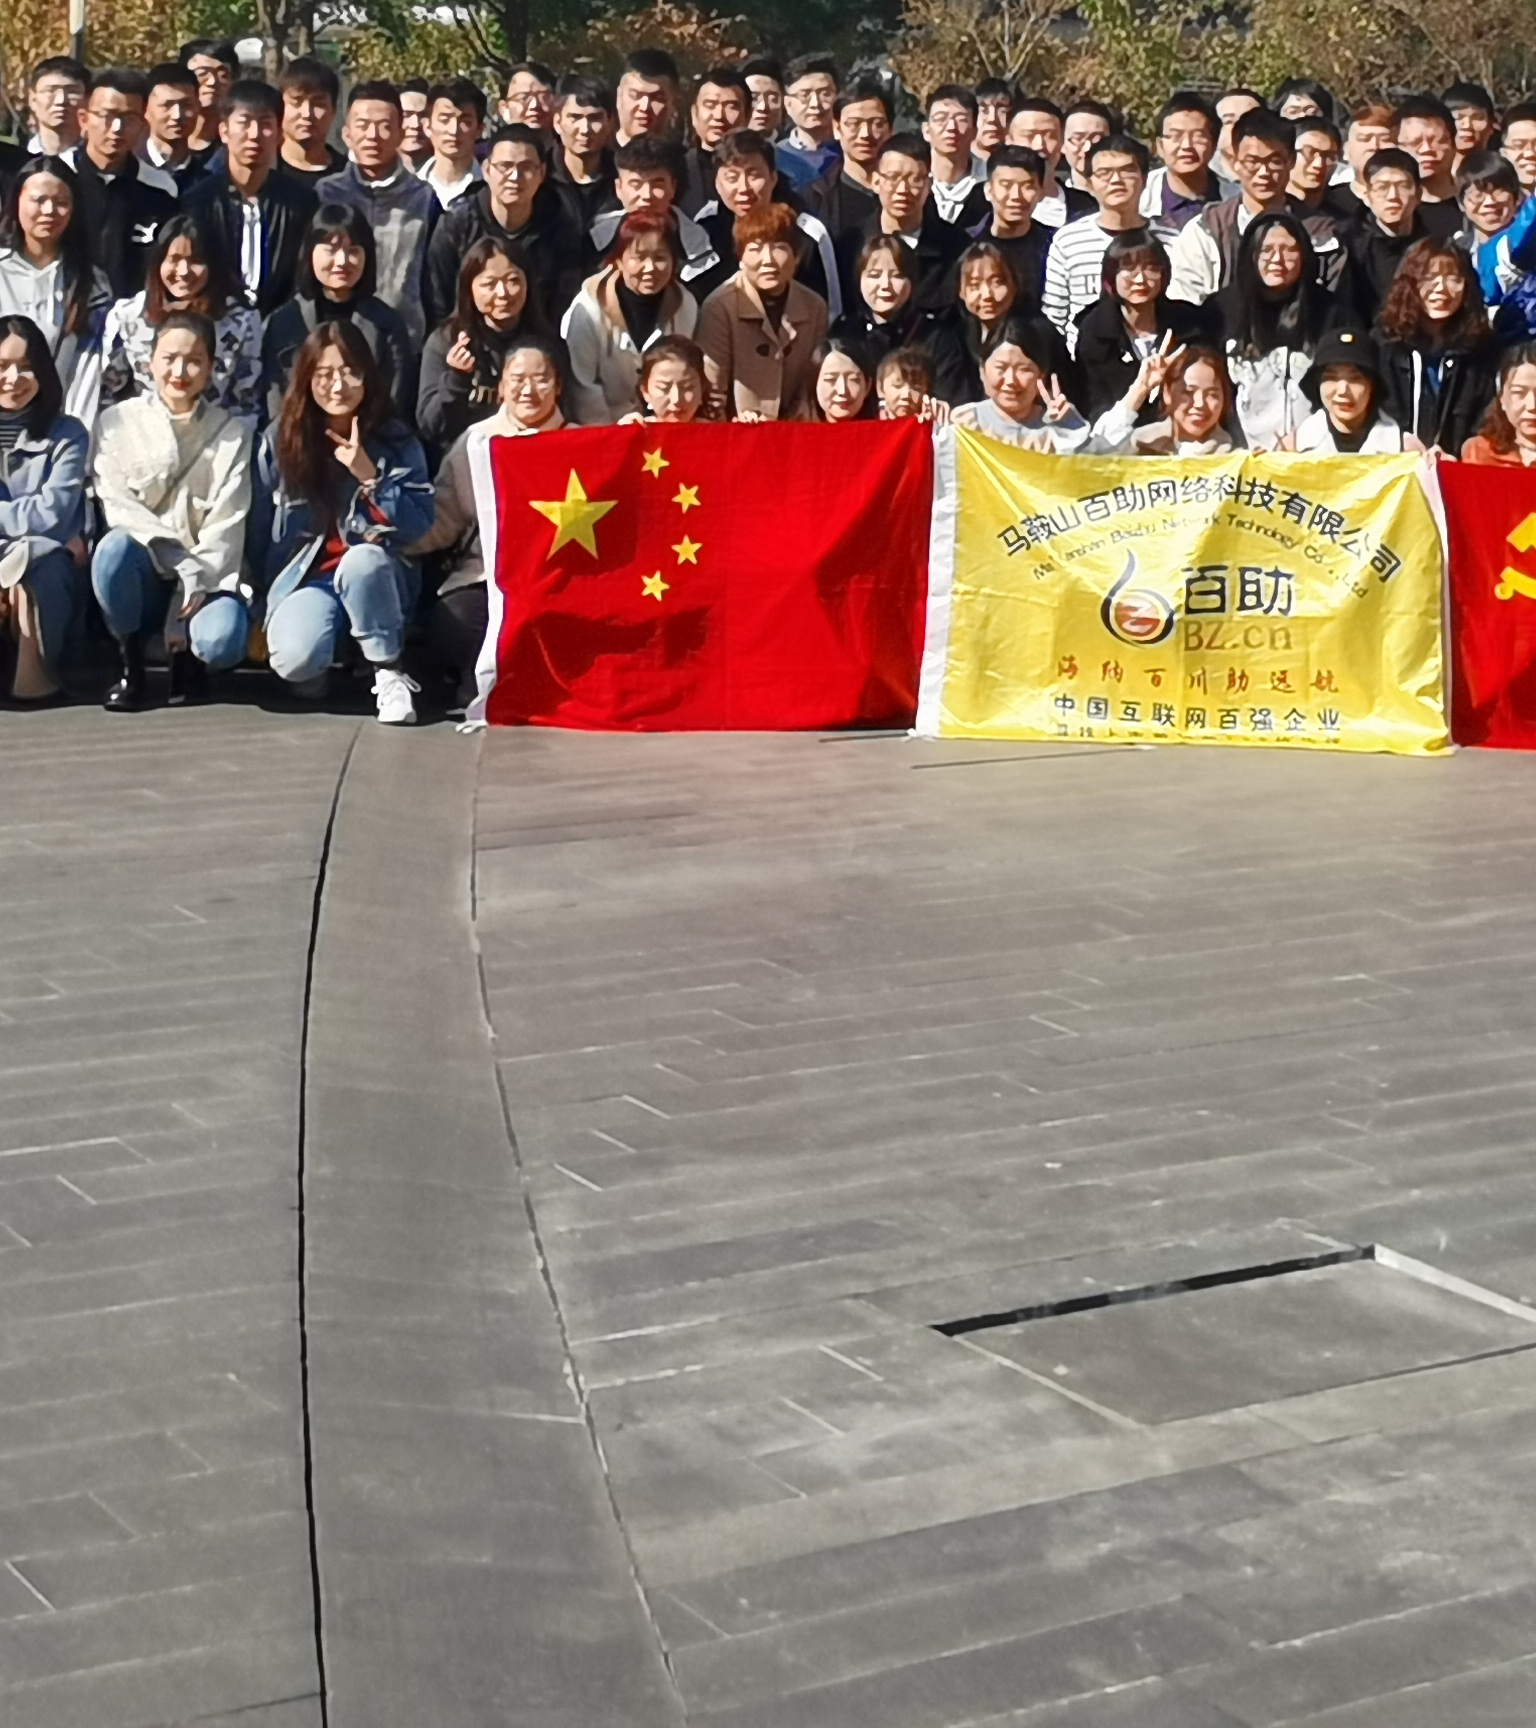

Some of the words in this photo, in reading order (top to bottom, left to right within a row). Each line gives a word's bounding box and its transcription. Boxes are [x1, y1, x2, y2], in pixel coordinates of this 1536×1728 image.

[997, 473, 1402, 583] 马鞍山百助网络科技有限公司
[1181, 564, 1294, 616] 百助
[1183, 620, 1293, 652] BZ.cn
[1057, 655, 1340, 695] 海纳百川助远航
[1054, 693, 1341, 732] 中国互联网百强企业
